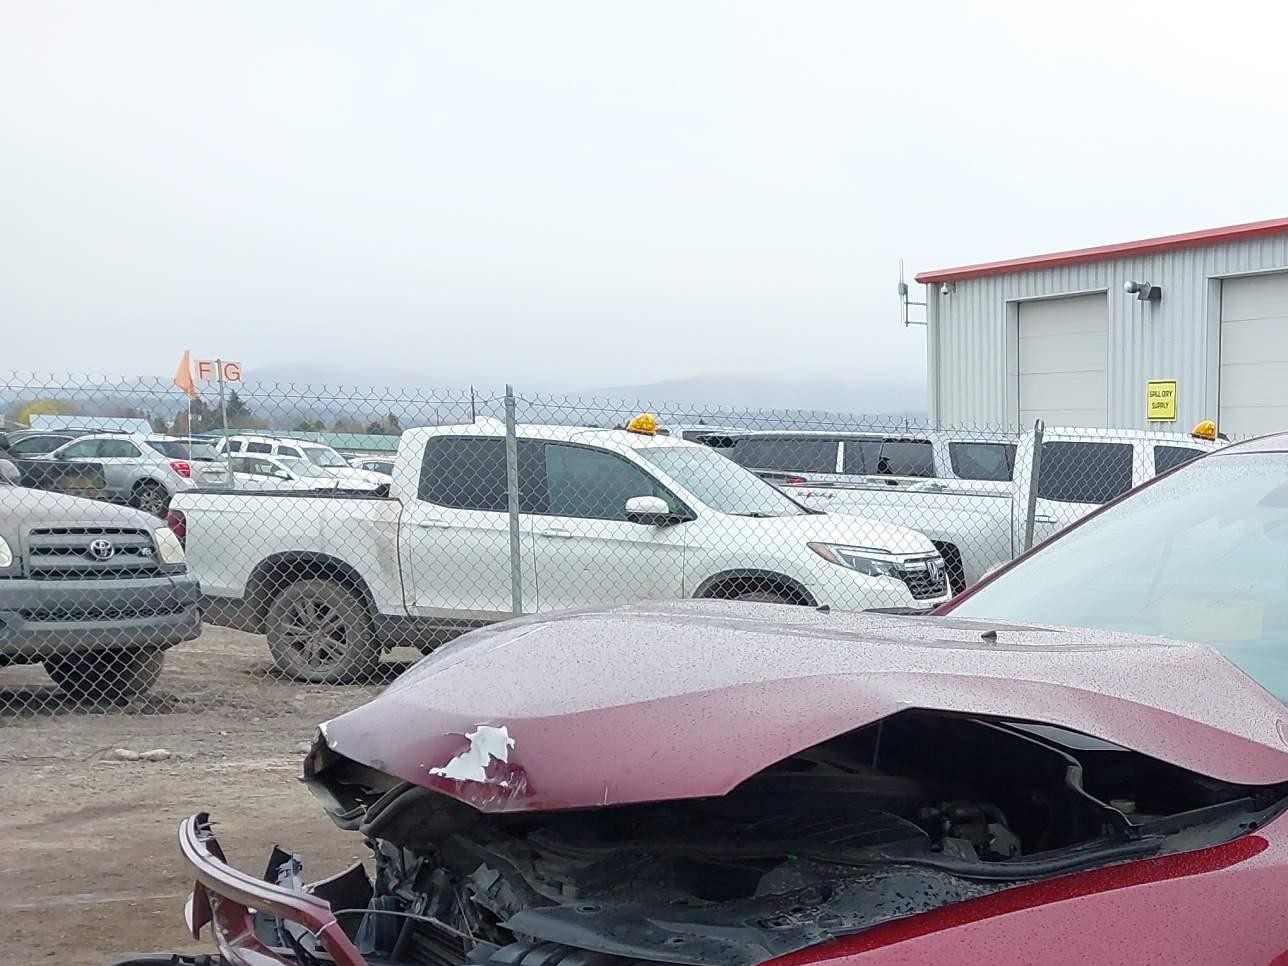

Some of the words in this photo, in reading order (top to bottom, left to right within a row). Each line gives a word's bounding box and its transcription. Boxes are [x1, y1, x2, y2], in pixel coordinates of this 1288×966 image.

[199, 361, 211, 380] F
[224, 362, 241, 382] G
[1151, 402, 1169, 410] SUPPLY
